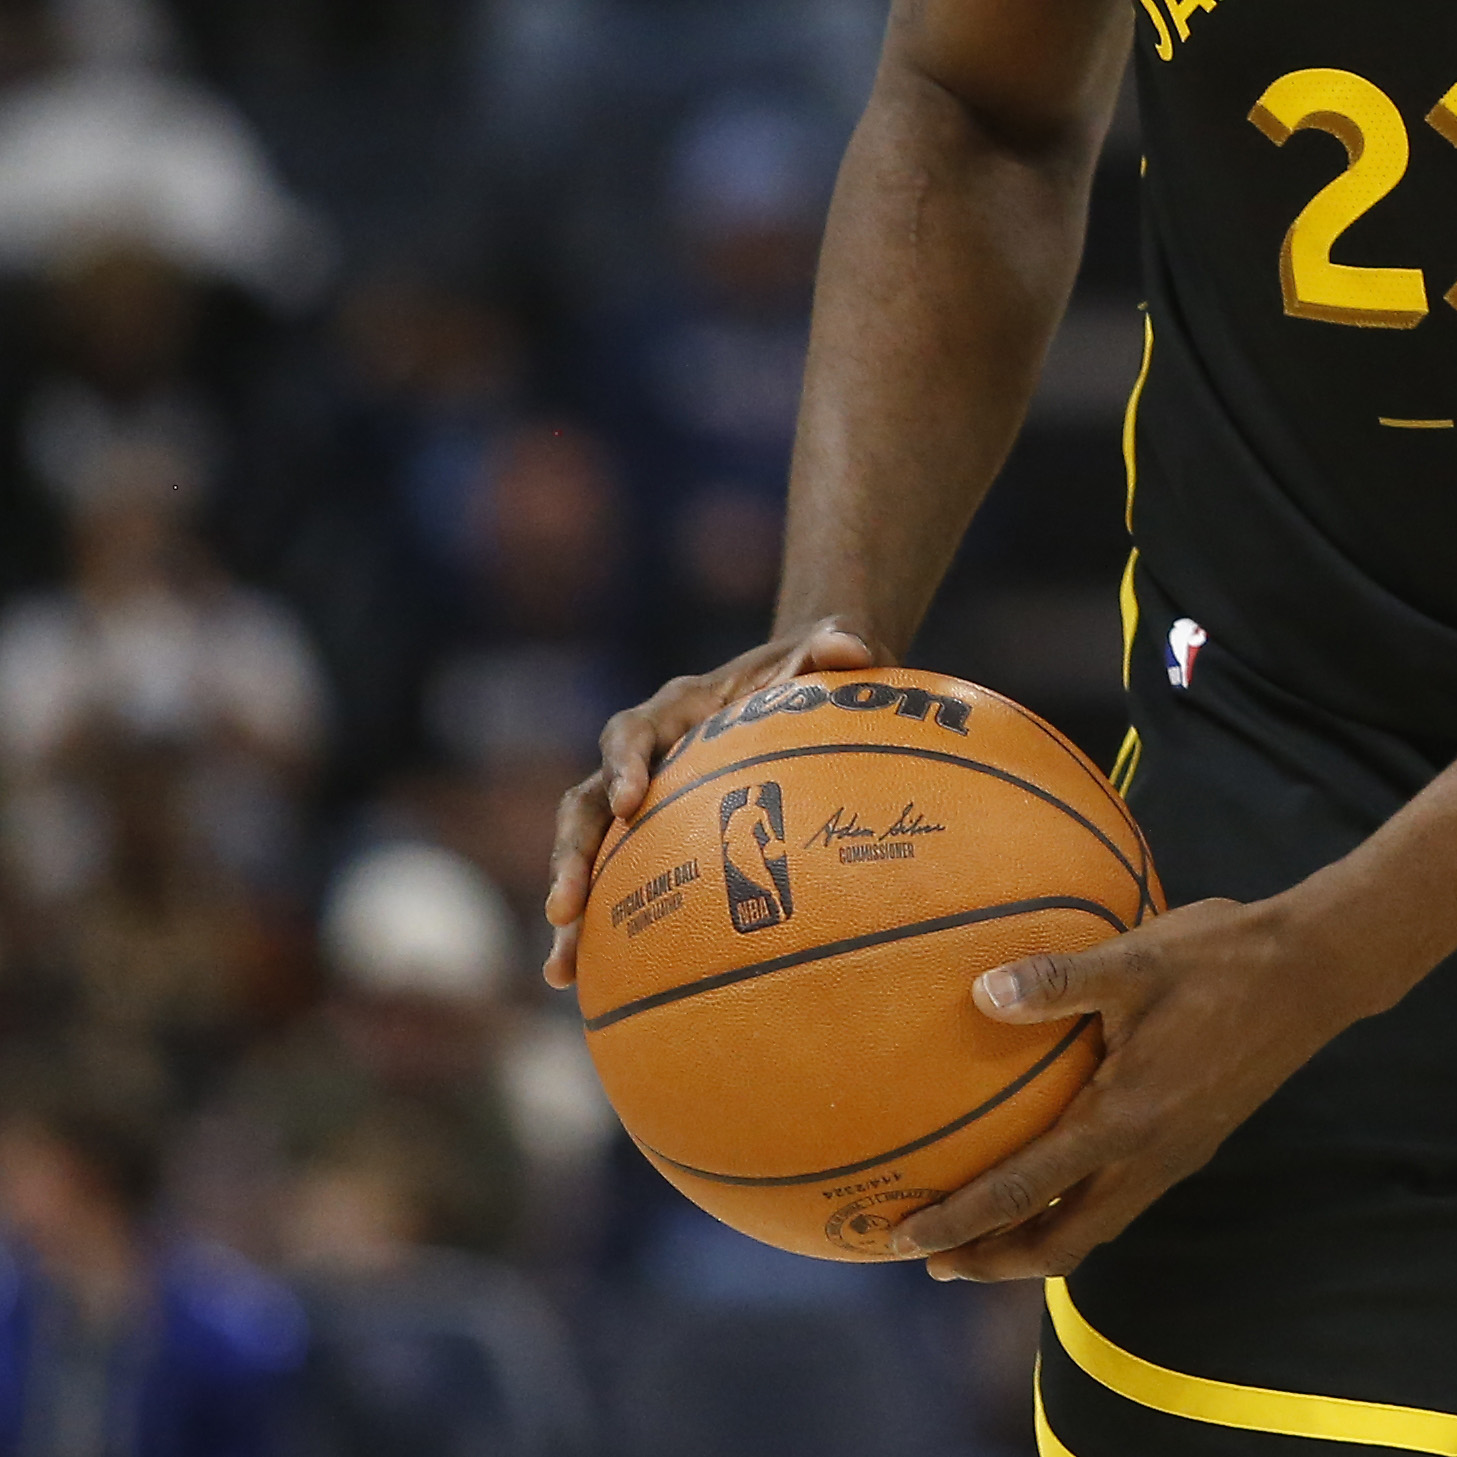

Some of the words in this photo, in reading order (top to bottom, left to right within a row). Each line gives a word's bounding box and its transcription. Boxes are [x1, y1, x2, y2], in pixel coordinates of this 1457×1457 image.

[839, 842, 915, 865] COMMISSIONER
[646, 870, 673, 903] GAME
[674, 858, 701, 887] BALL
[736, 896, 771, 925] NBA
